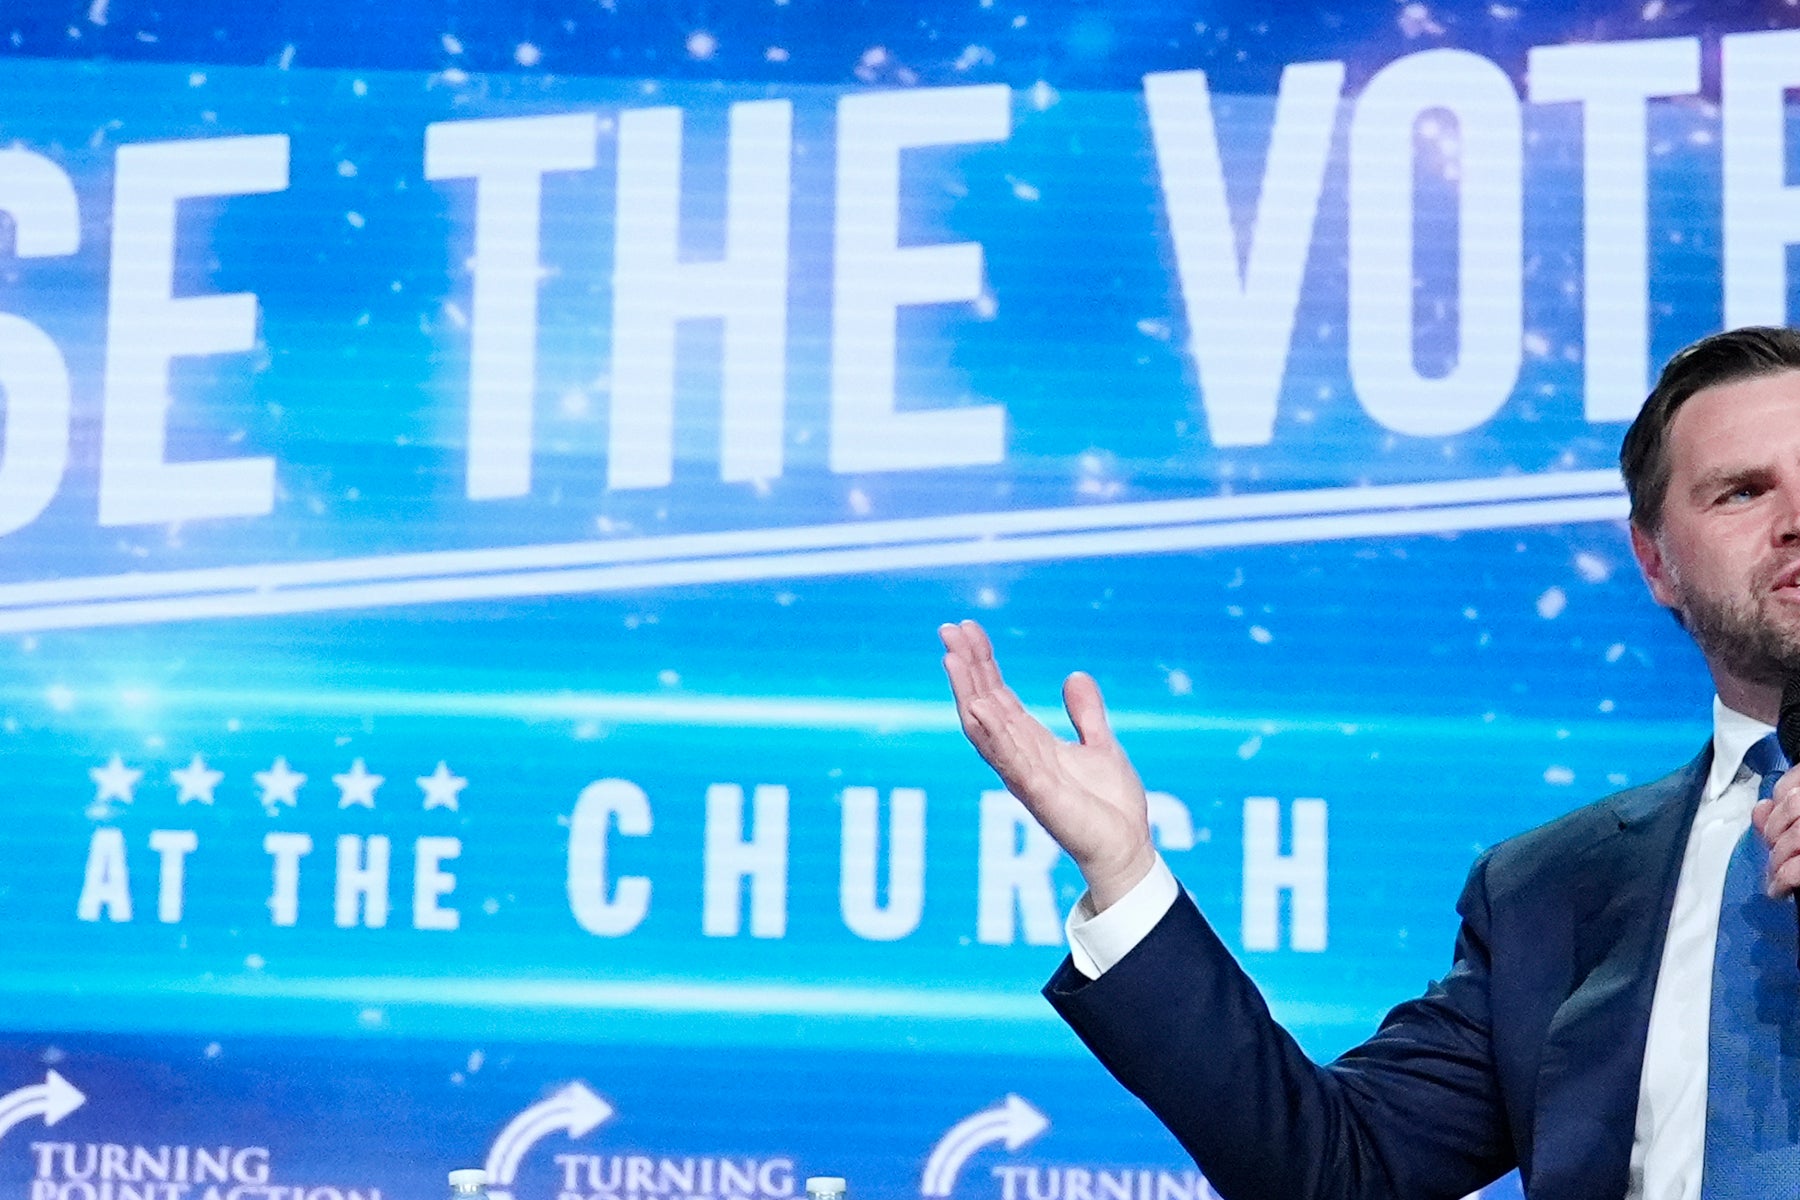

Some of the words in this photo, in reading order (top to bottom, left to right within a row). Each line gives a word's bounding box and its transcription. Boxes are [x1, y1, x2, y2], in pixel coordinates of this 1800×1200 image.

[424, 84, 1010, 499] THE
[77, 828, 198, 923] AT
[264, 832, 463, 930] THE
[566, 777, 1328, 952] CHURH
[30, 1141, 270, 1185] TURNING
[555, 1154, 793, 1195] TURNING
